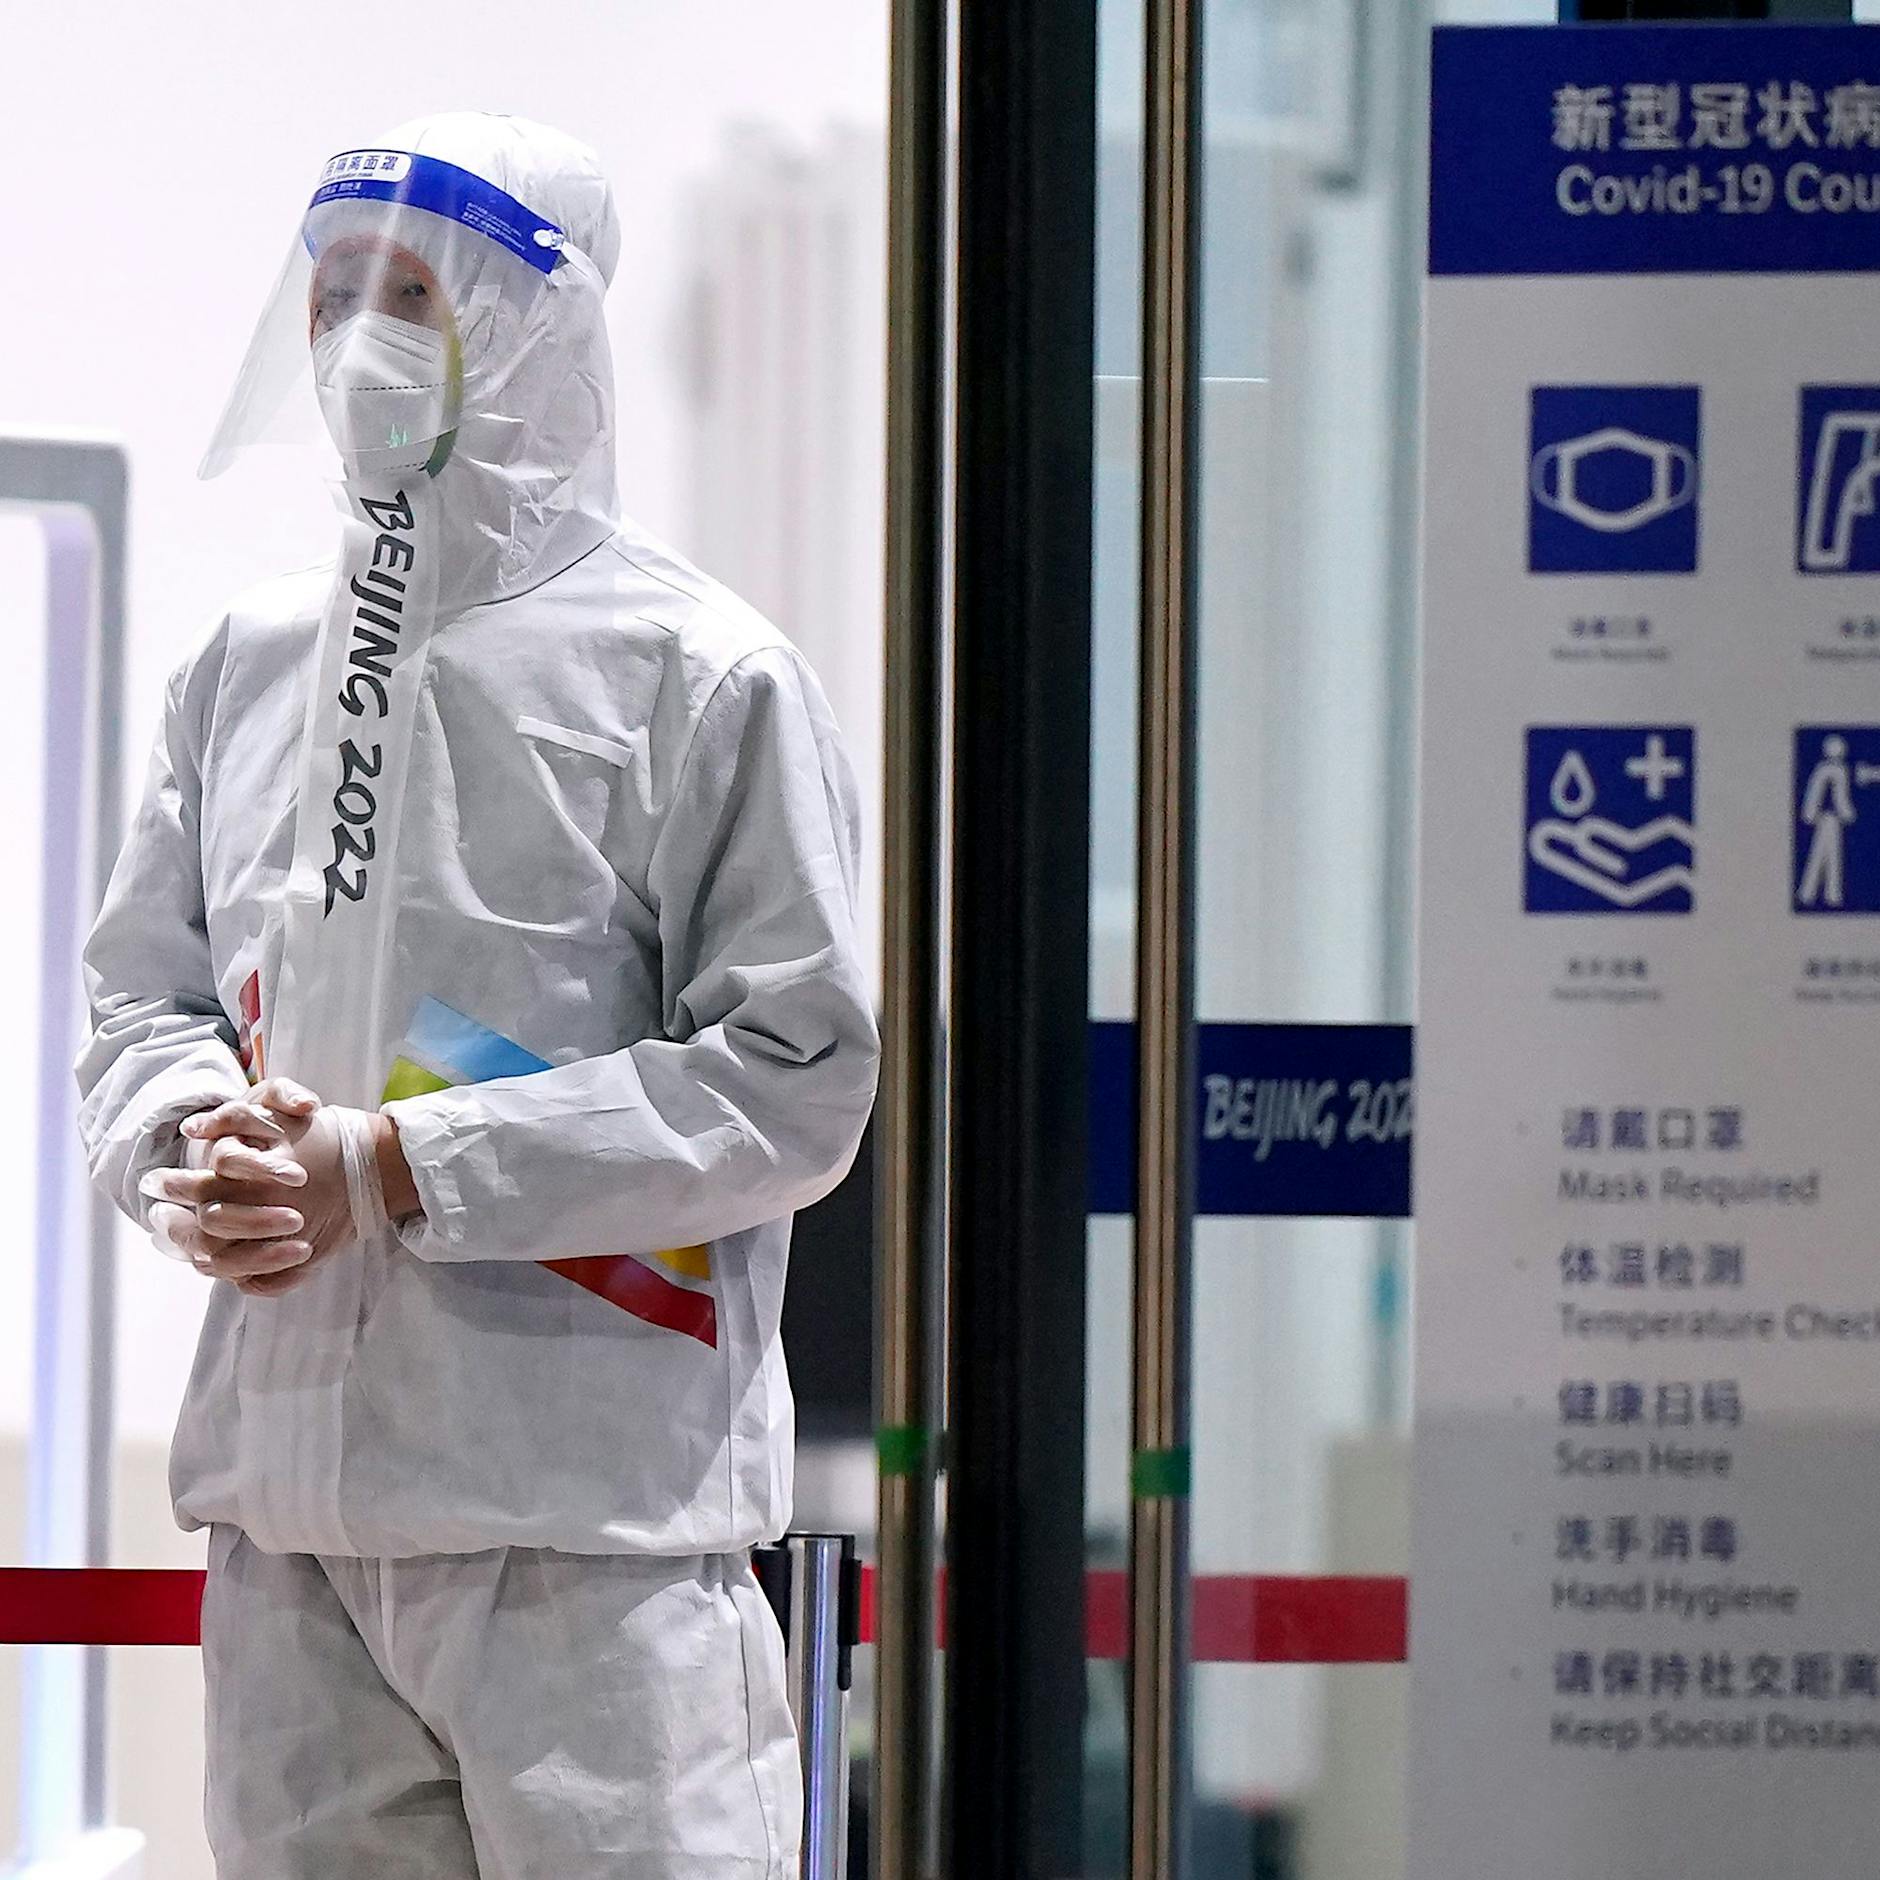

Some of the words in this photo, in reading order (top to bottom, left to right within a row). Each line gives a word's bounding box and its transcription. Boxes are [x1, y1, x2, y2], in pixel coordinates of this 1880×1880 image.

[1551, 80, 1880, 151] 新型冠状病
[1556, 163, 1774, 215] Covid-19
[1785, 162, 1880, 214] Cou
[338, 489, 415, 718] BEIJING
[323, 738, 383, 920] 2022
[1204, 1073, 1338, 1162] BEIJING
[1560, 1105, 1744, 1150] 请戴口罩
[1558, 1168, 1648, 1202] Mask
[1659, 1166, 1820, 1207] Required
[1559, 1242, 1744, 1287] 体温检测
[1558, 1302, 1776, 1341] Temperature
[1555, 1438, 1641, 1478] Scan
[1649, 1439, 1733, 1478] Here
[1555, 1514, 1737, 1563] 洗手消毒
[1552, 1578, 1646, 1614] Hand
[1652, 1578, 1798, 1620] Hygiene
[1554, 1650, 1880, 1698] 请保持社交距离
[1551, 1713, 1641, 1751] Keep
[1649, 1709, 1757, 1747] Social
